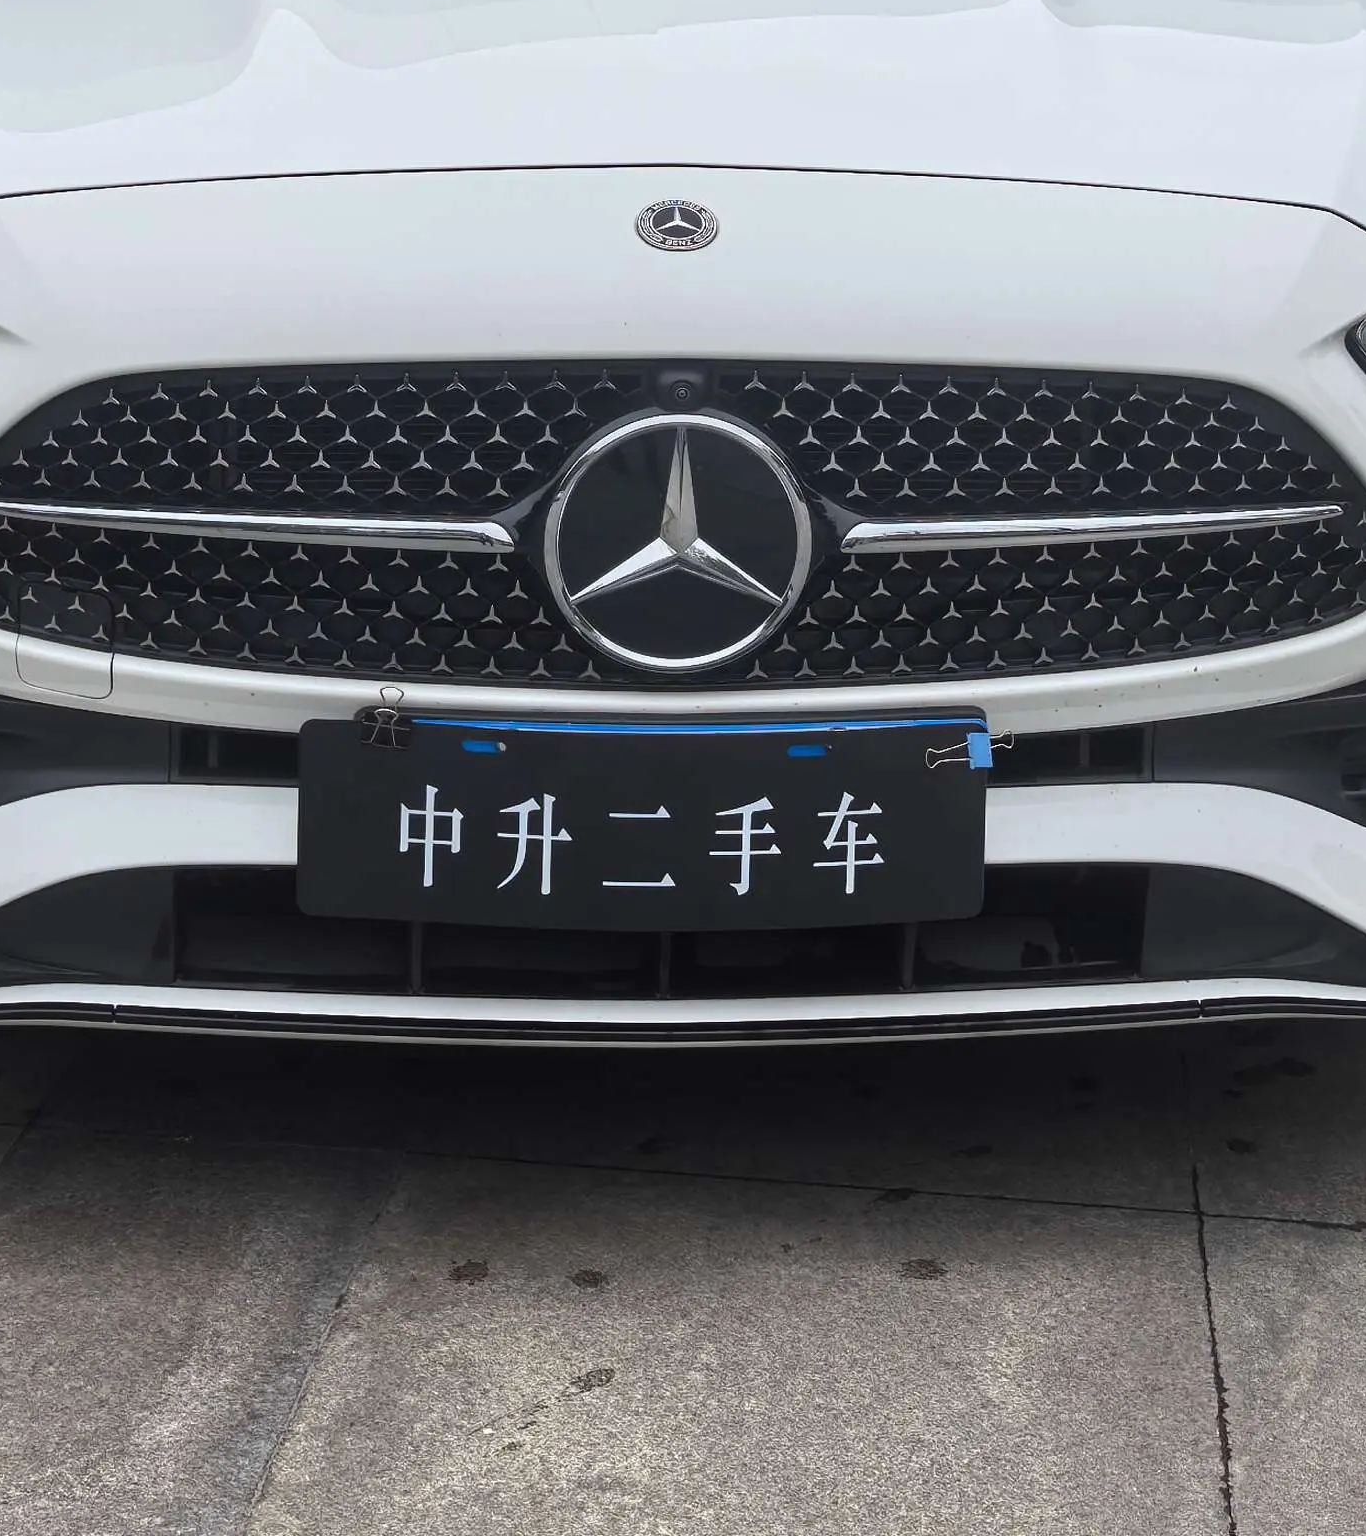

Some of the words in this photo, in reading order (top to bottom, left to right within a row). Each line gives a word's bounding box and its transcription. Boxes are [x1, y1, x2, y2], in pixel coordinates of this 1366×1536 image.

[398, 783, 886, 896] 中升二手车
